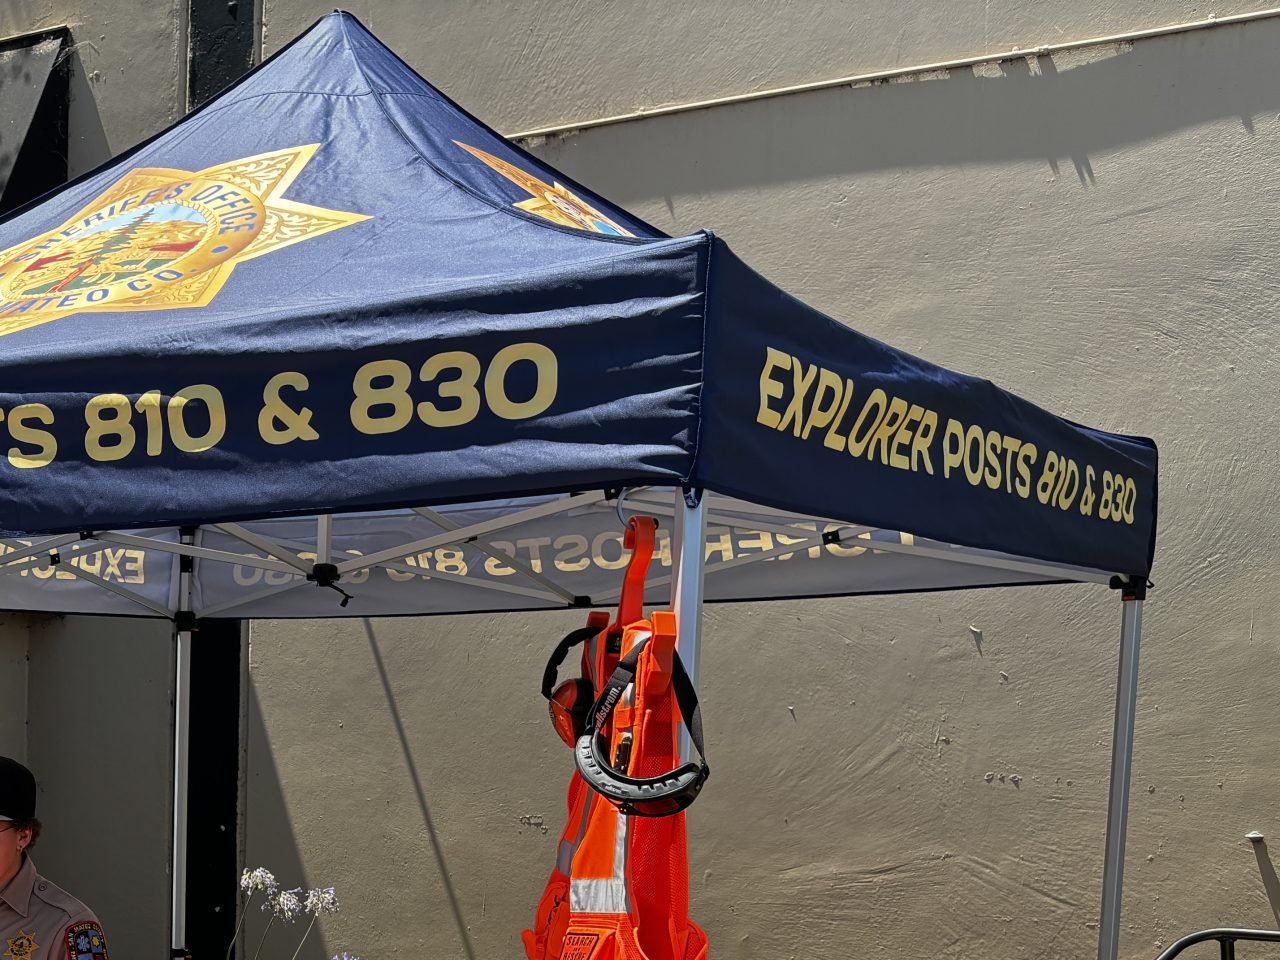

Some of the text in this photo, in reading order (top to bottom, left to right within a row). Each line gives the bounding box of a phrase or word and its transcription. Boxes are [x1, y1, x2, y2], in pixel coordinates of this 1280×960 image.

[197, 183, 258, 236] OFFICE
[83, 384, 227, 462] 810
[257, 371, 320, 446] &
[349, 342, 559, 435] 830
[756, 346, 1137, 526] EXPLORER POSTS 810 & 830
